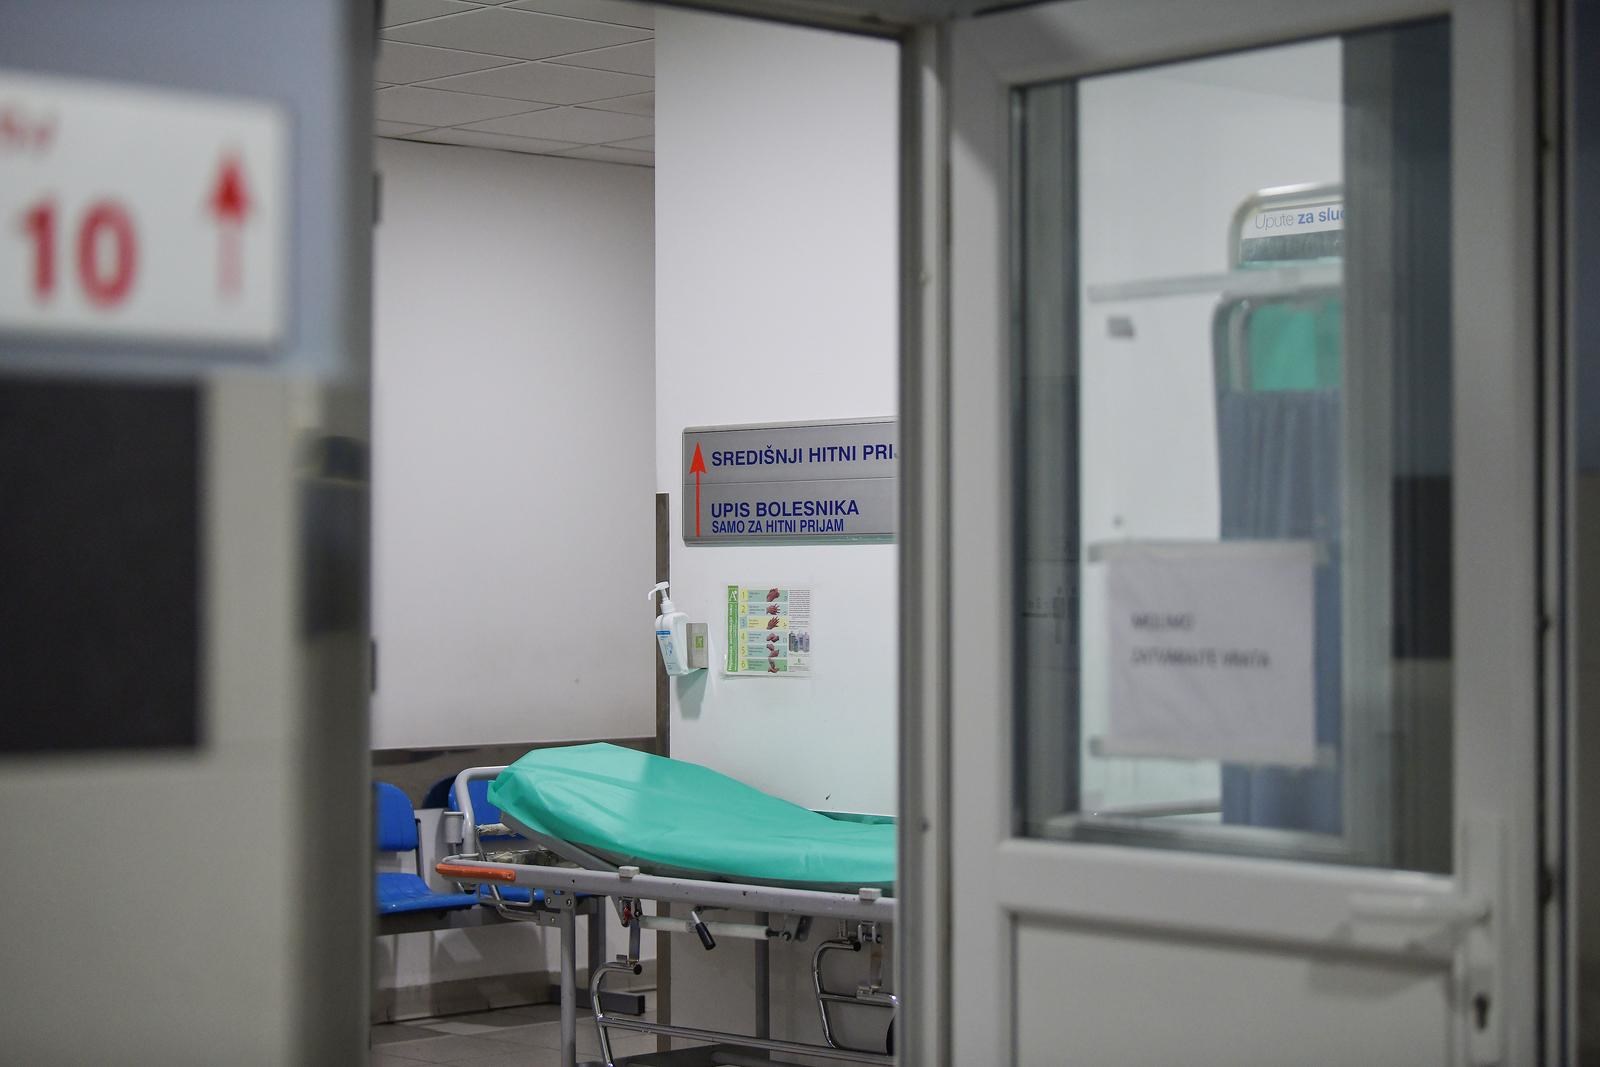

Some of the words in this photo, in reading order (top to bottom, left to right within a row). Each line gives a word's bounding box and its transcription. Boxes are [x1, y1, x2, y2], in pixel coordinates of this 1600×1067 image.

[1255, 214, 1294, 230] Upute
[1298, 212, 1314, 224] za
[20, 199, 138, 310] 10
[711, 444, 803, 466] SREDIŠNJI
[808, 445, 857, 463] HITNI
[862, 443, 897, 461] PRI
[711, 502, 750, 518] UPIS
[755, 500, 859, 517] BOLESNIKA
[712, 520, 745, 534] SAMO
[748, 520, 763, 533] ZA
[766, 519, 796, 533] HITNI
[800, 518, 844, 532] PRIJAM
